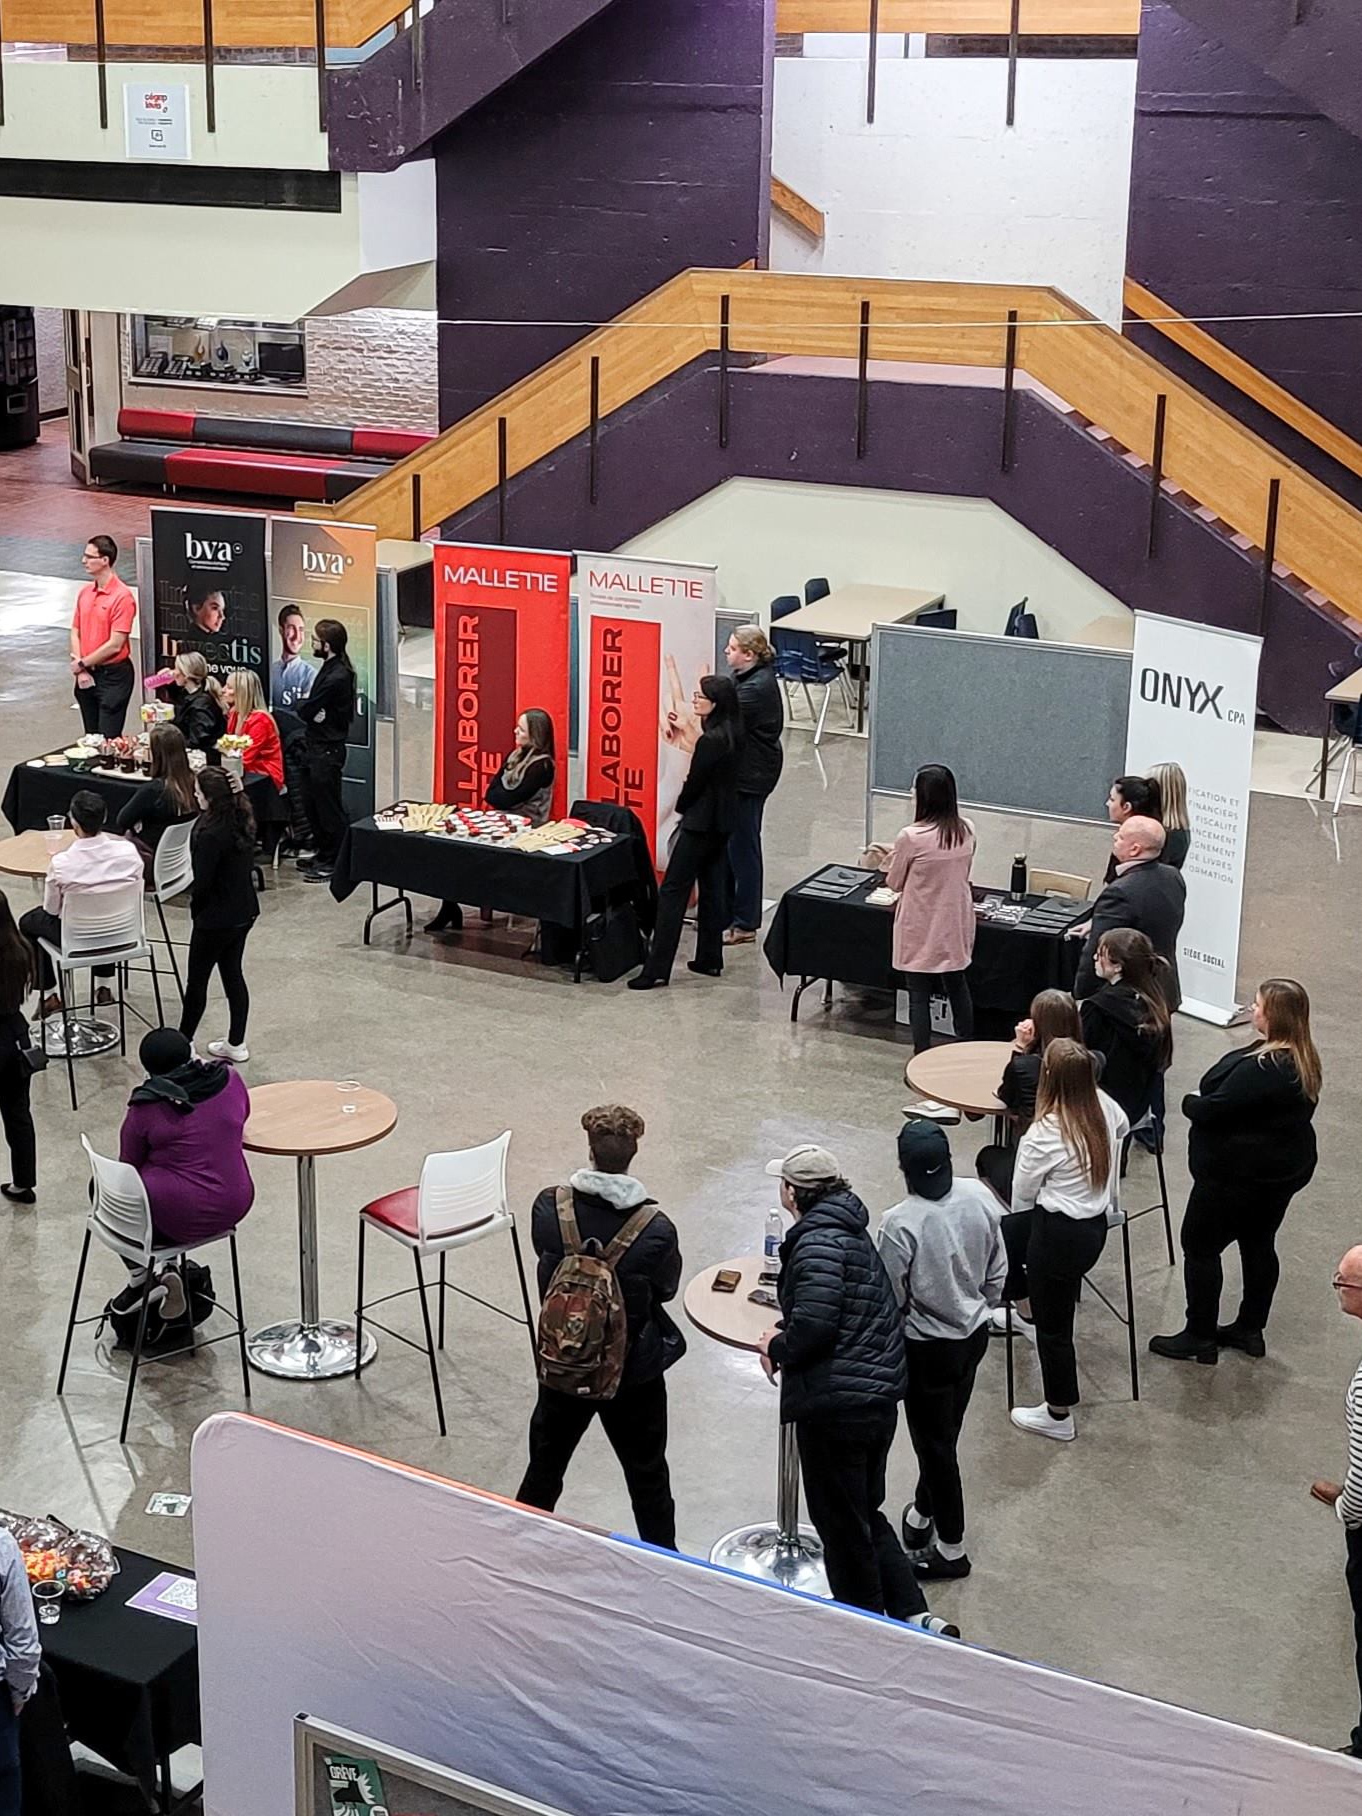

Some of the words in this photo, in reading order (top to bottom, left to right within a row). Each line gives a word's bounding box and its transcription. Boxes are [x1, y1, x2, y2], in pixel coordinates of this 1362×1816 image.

[185, 532, 234, 562] bva
[302, 544, 344, 574] bva
[444, 565, 558, 593] MALLETTE
[589, 570, 703, 599] MALLETTE
[1140, 668, 1225, 720] ONYX
[1227, 709, 1246, 726] CPA
